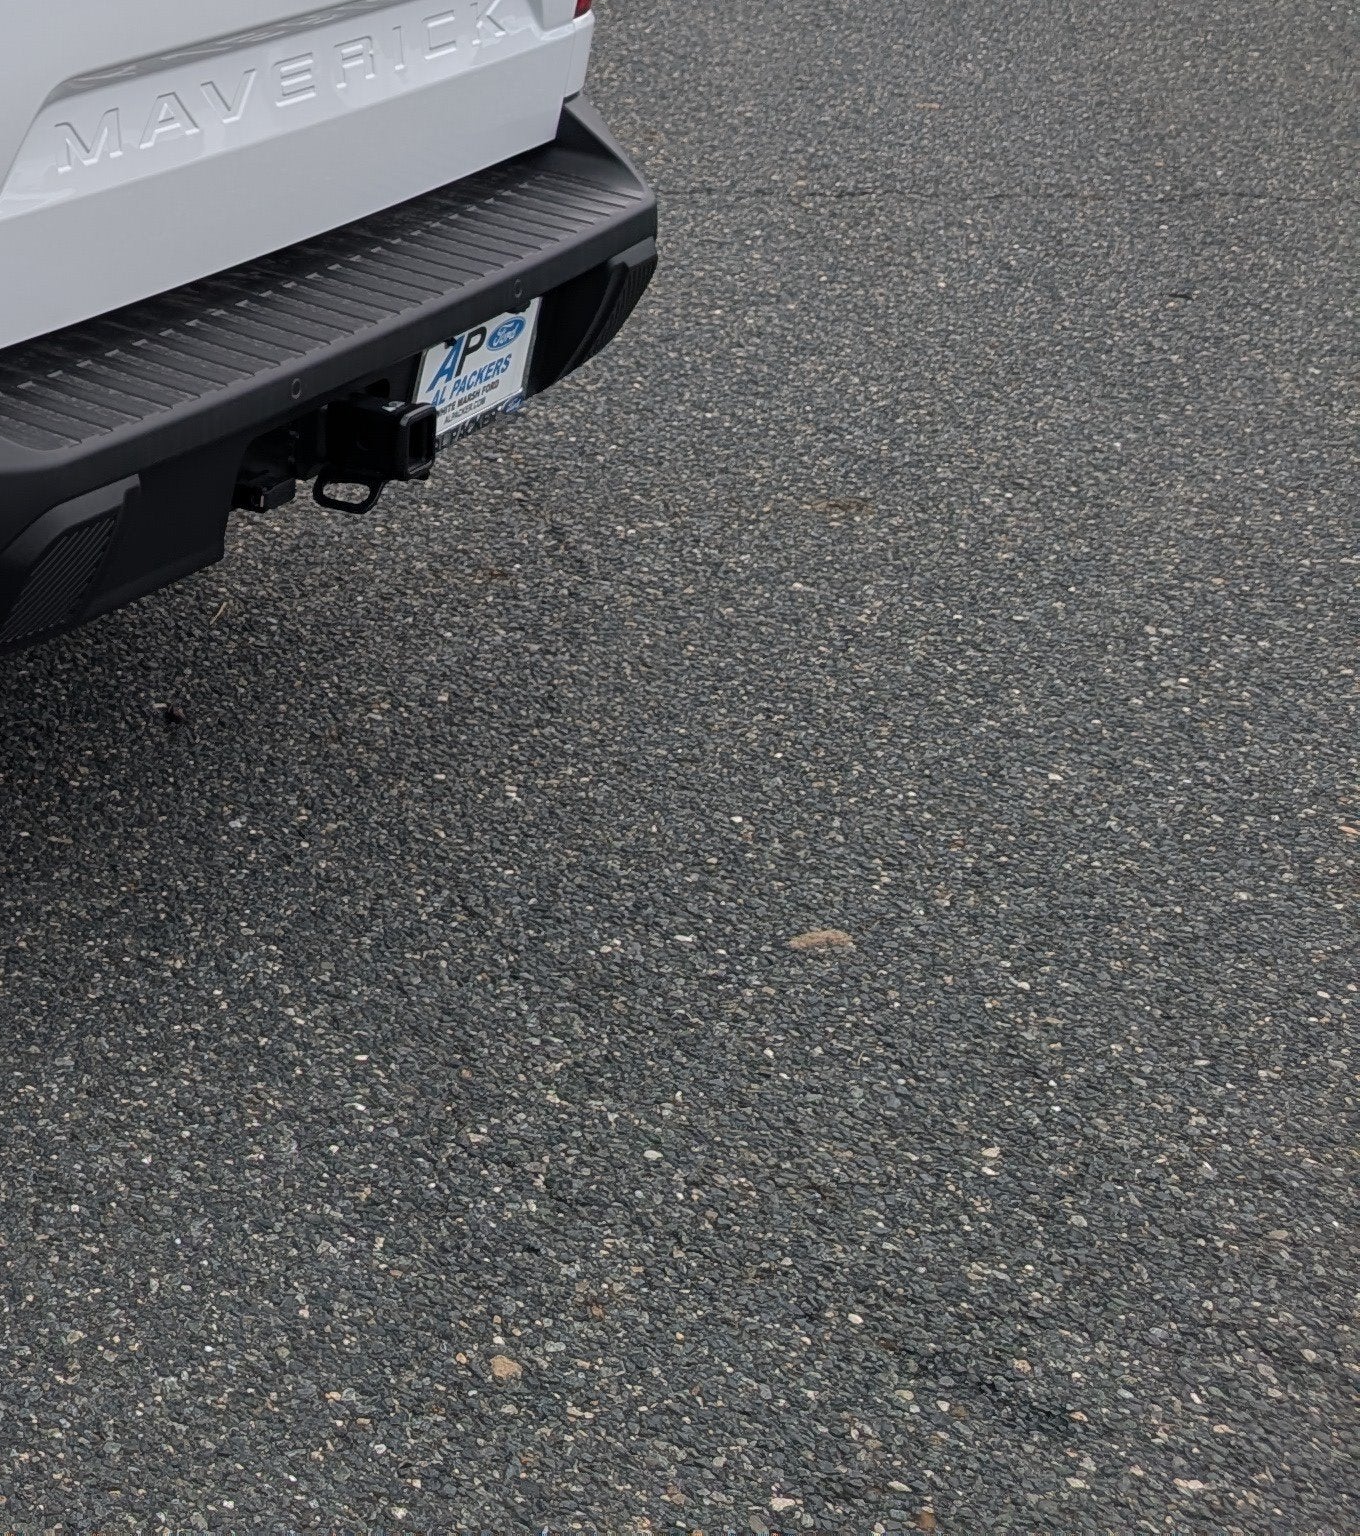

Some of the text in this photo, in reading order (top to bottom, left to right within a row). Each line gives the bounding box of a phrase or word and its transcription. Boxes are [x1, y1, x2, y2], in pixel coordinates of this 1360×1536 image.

[492, 320, 520, 346] Ford
[425, 326, 488, 394] AP
[431, 353, 513, 409] AL PACKERS
[457, 389, 480, 407] MARSH
[481, 378, 500, 395] FORD
